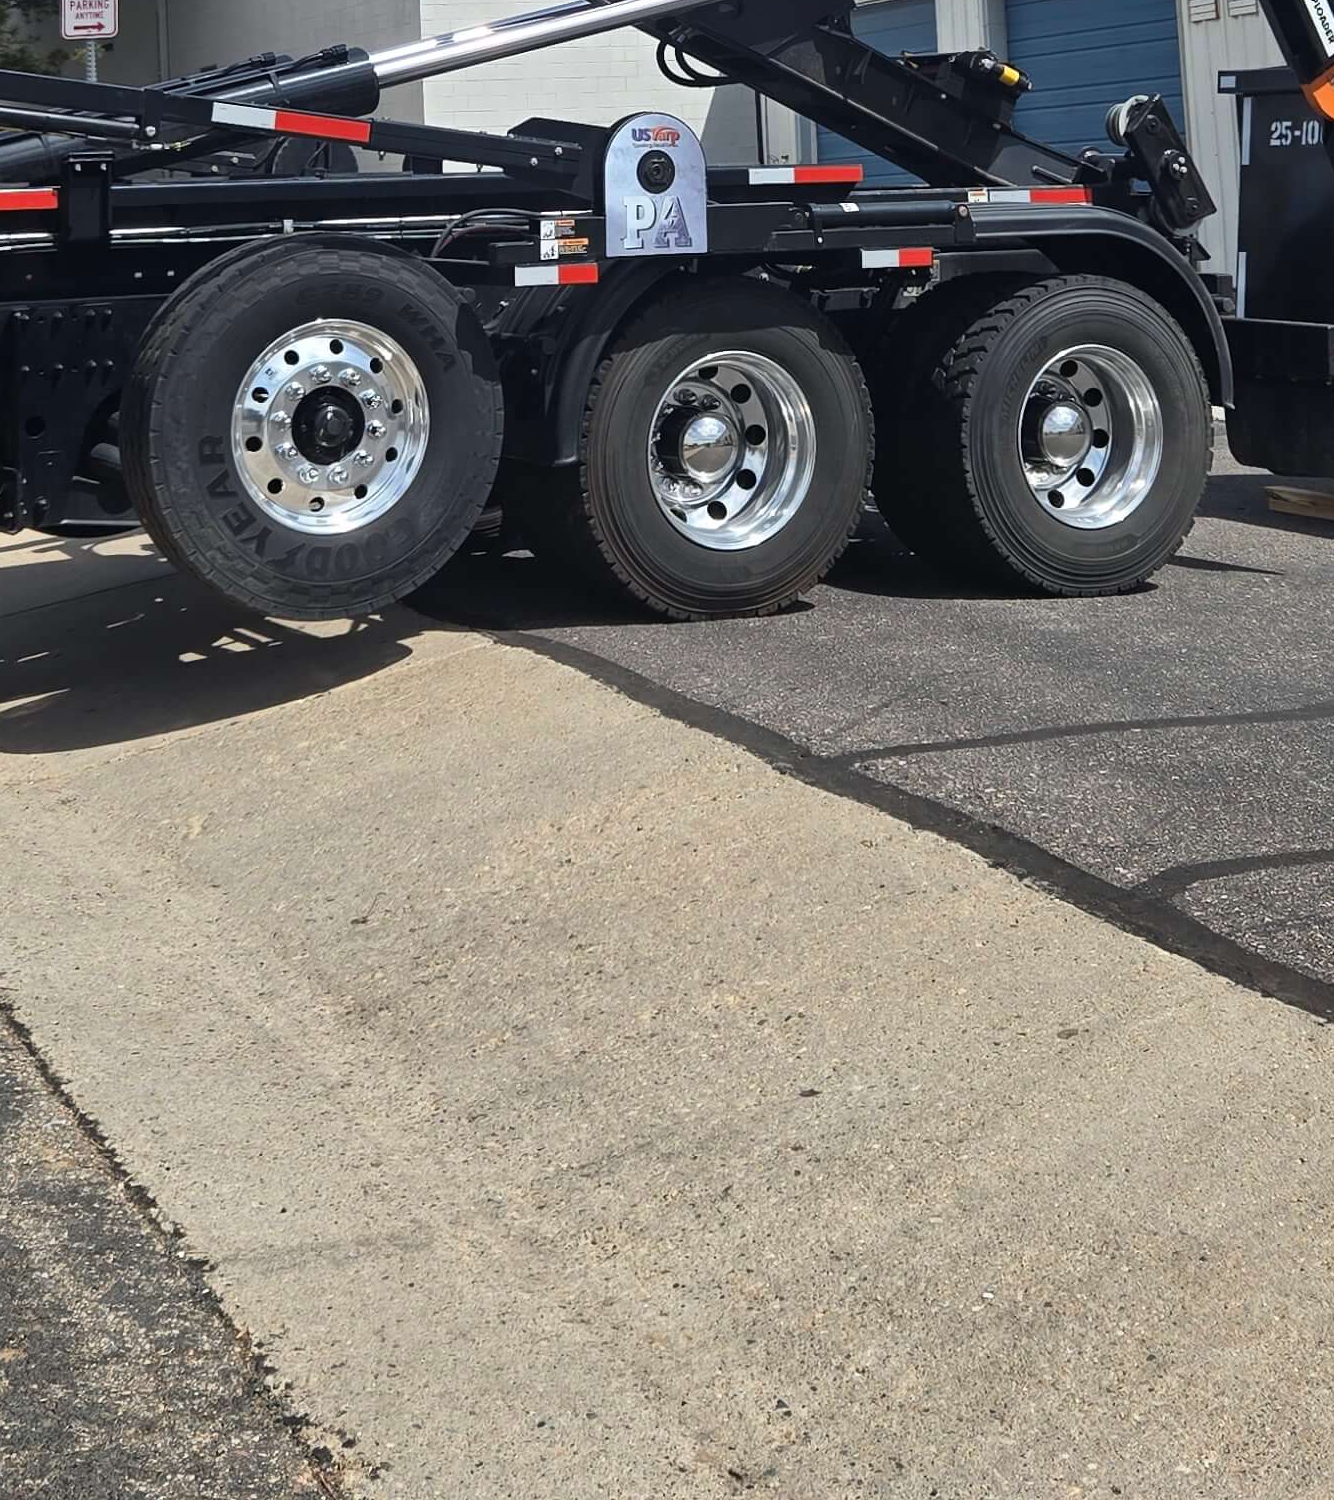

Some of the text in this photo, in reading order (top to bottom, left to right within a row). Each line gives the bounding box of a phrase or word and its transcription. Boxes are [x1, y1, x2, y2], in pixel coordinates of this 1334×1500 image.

[70, 0, 110, 11] PARKING
[75, 10, 105, 20] ANYTIME
[1269, 120, 1324, 146] 25-10
[620, 196, 692, 250] PA
[199, 434, 416, 578] GOODYEAR
